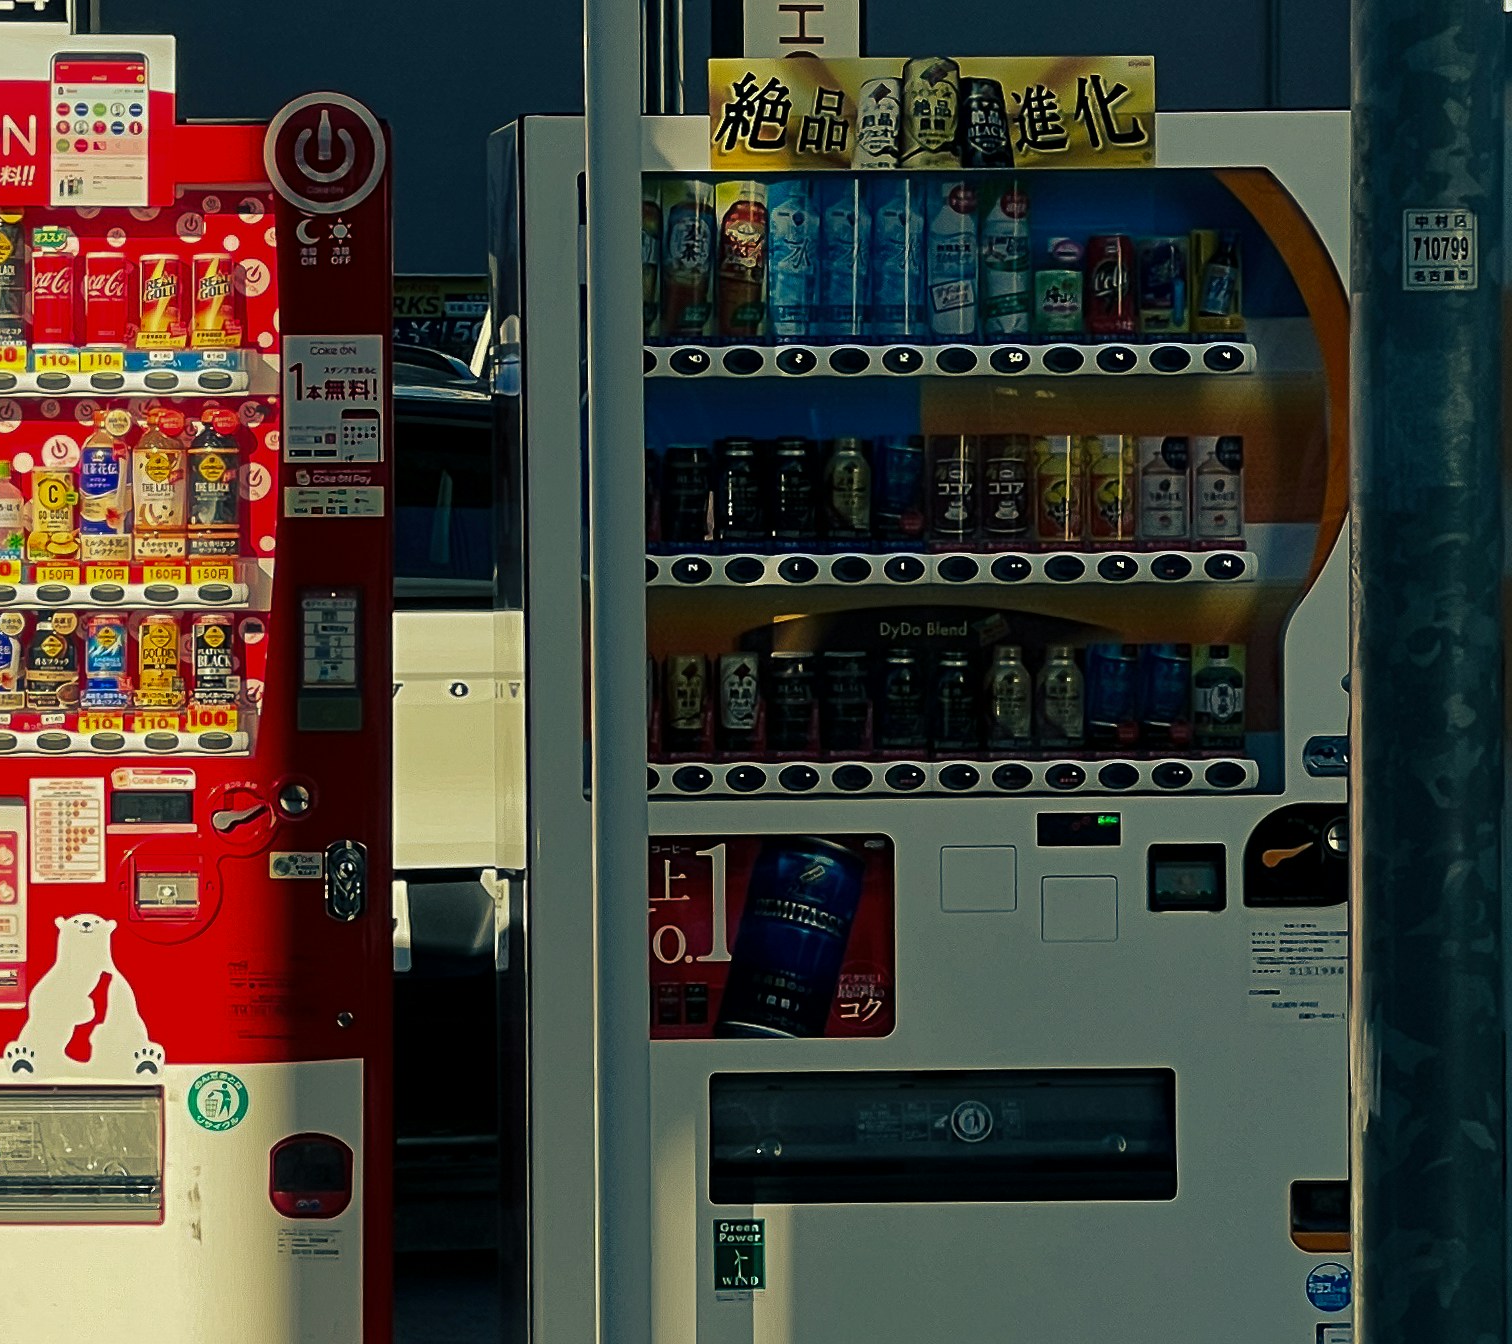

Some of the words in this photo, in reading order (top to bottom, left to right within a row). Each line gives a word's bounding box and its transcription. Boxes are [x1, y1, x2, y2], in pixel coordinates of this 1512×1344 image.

[713, 71, 850, 153] 絶品
[1011, 73, 1148, 152] 進化
[968, 127, 1007, 139] BLACK
[1415, 215, 1466, 228] 中村区
[1413, 236, 1469, 261] 710799
[330, 256, 351, 264] OFF
[1415, 270, 1468, 282] 名古屋市
[310, 347, 337, 355] Coke
[340, 346, 357, 355] ON
[353, 474, 371, 484] Pay
[207, 483, 230, 492] BLACK
[988, 482, 1025, 495] ココア
[48, 485, 58, 504] C
[41, 569, 74, 580] 150円
[92, 569, 125, 580] 170円
[149, 569, 182, 580] 160円
[196, 569, 229, 580] 150円
[879, 621, 923, 637] DyDo
[926, 621, 968, 637] Blend
[198, 656, 231, 667] BLACK
[840, 999, 882, 1021] コク
[719, 1223, 759, 1232] Green
[719, 1233, 761, 1242] Power
[722, 1276, 759, 1285] WIND
